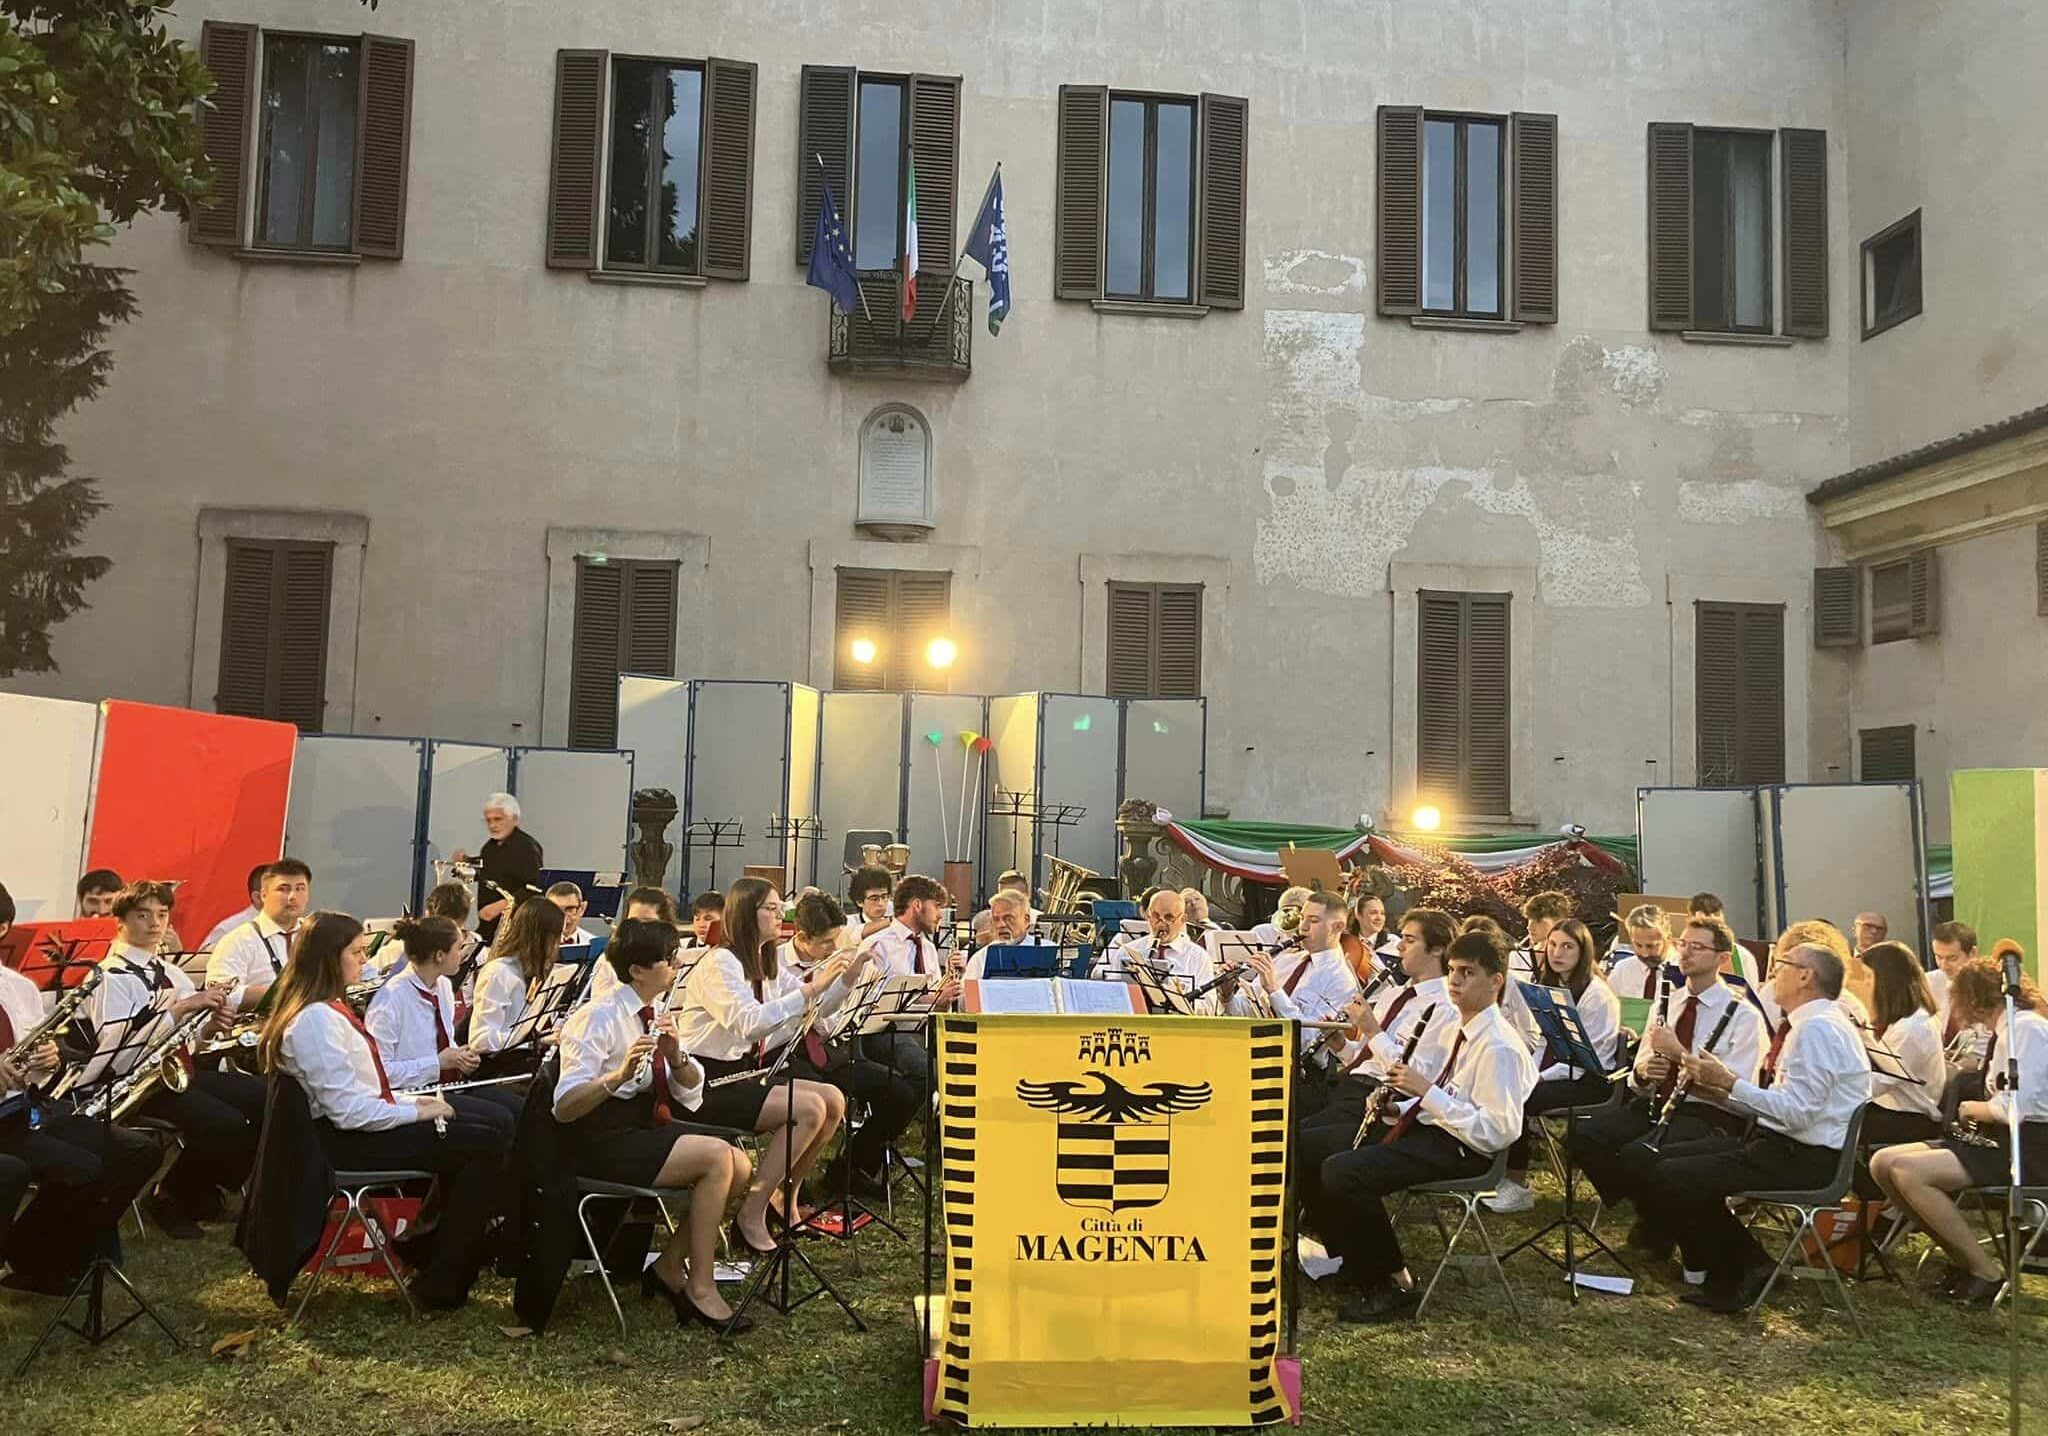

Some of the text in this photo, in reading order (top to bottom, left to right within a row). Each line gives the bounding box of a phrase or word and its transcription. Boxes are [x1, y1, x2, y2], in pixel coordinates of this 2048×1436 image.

[1080, 1217, 1143, 1232] Città di
[1015, 1234, 1208, 1262] MAGENTA
